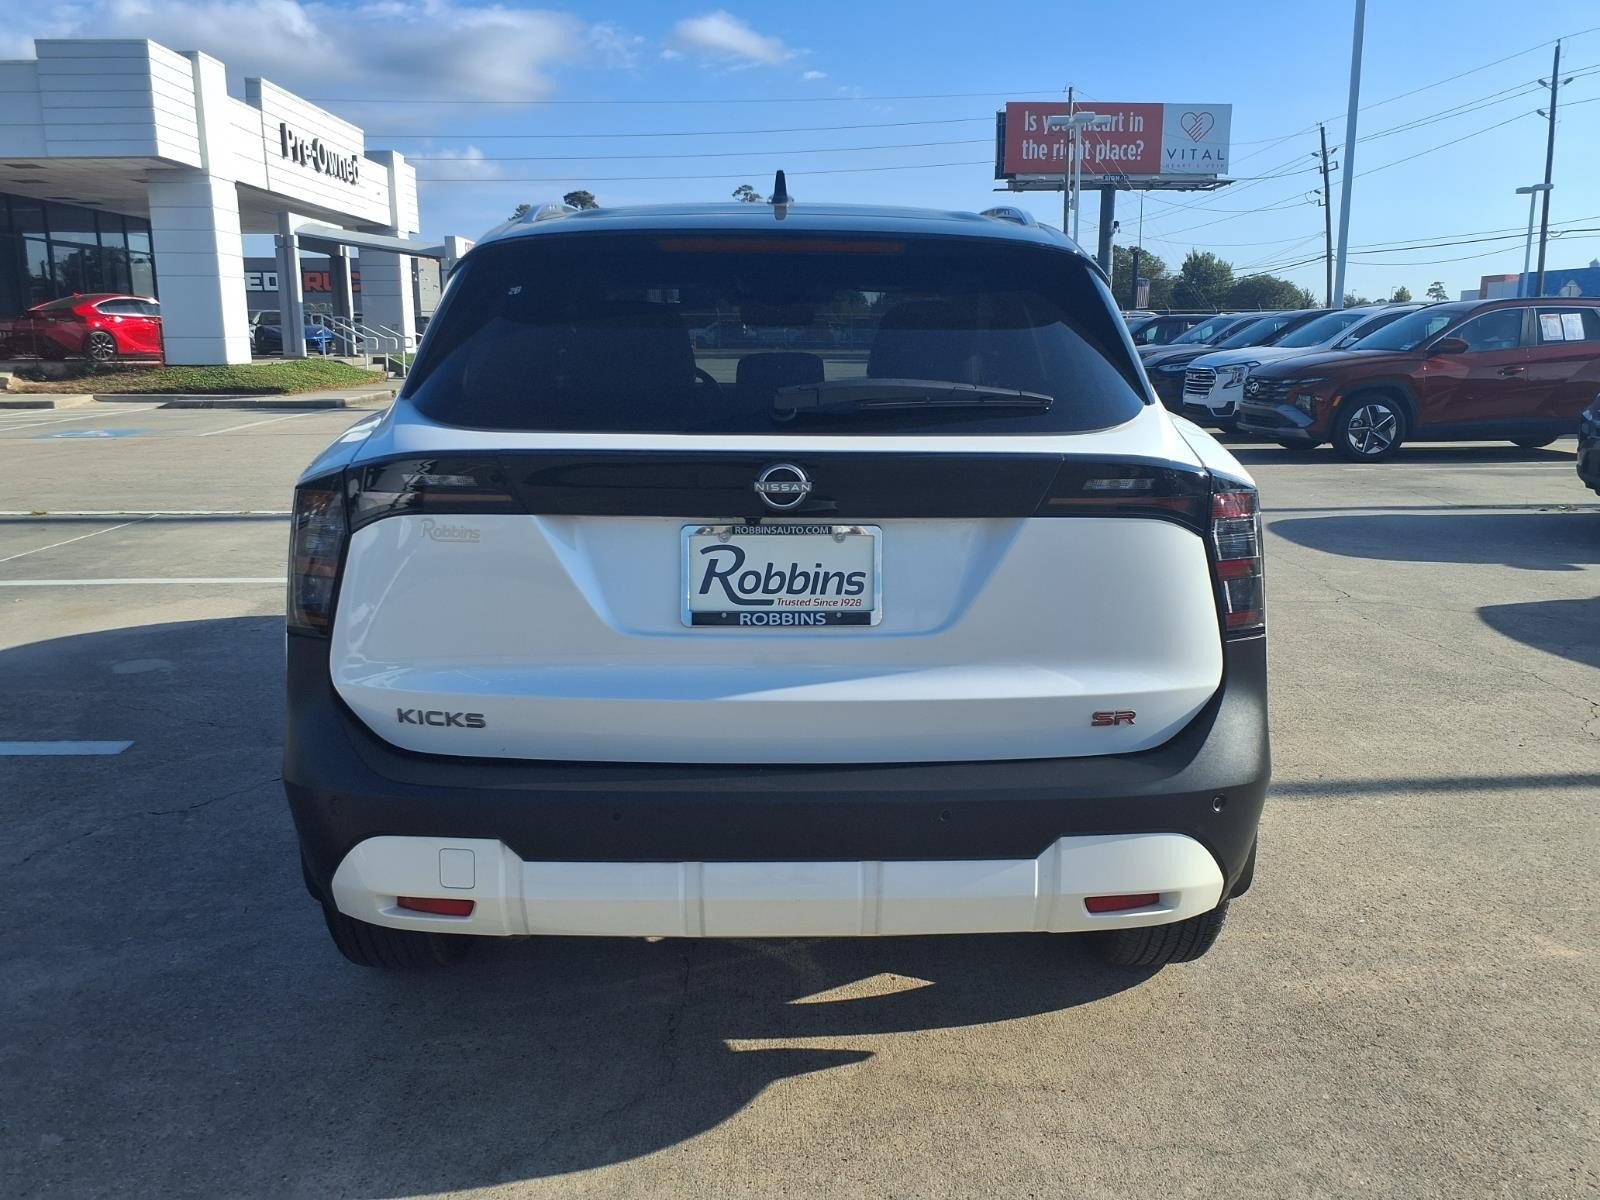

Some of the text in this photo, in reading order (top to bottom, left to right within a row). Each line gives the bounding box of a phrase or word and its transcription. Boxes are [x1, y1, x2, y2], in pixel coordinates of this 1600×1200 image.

[1024, 111, 1037, 131] Is
[1129, 112, 1143, 132] in
[280, 122, 360, 185] Pre-Owned
[1022, 139, 1048, 160] the
[1096, 139, 1144, 163] place?
[1166, 148, 1225, 160] VITAL
[755, 483, 810, 492] NISSAN
[420, 518, 480, 543] Robbins
[735, 526, 829, 535] ROBBINSAUTO.COM
[698, 544, 867, 606] Robbins
[777, 598, 862, 607] Trusted Since 1928
[739, 612, 826, 626] ROBBINS
[397, 708, 486, 728] KICKS
[1091, 711, 1136, 726] SR
